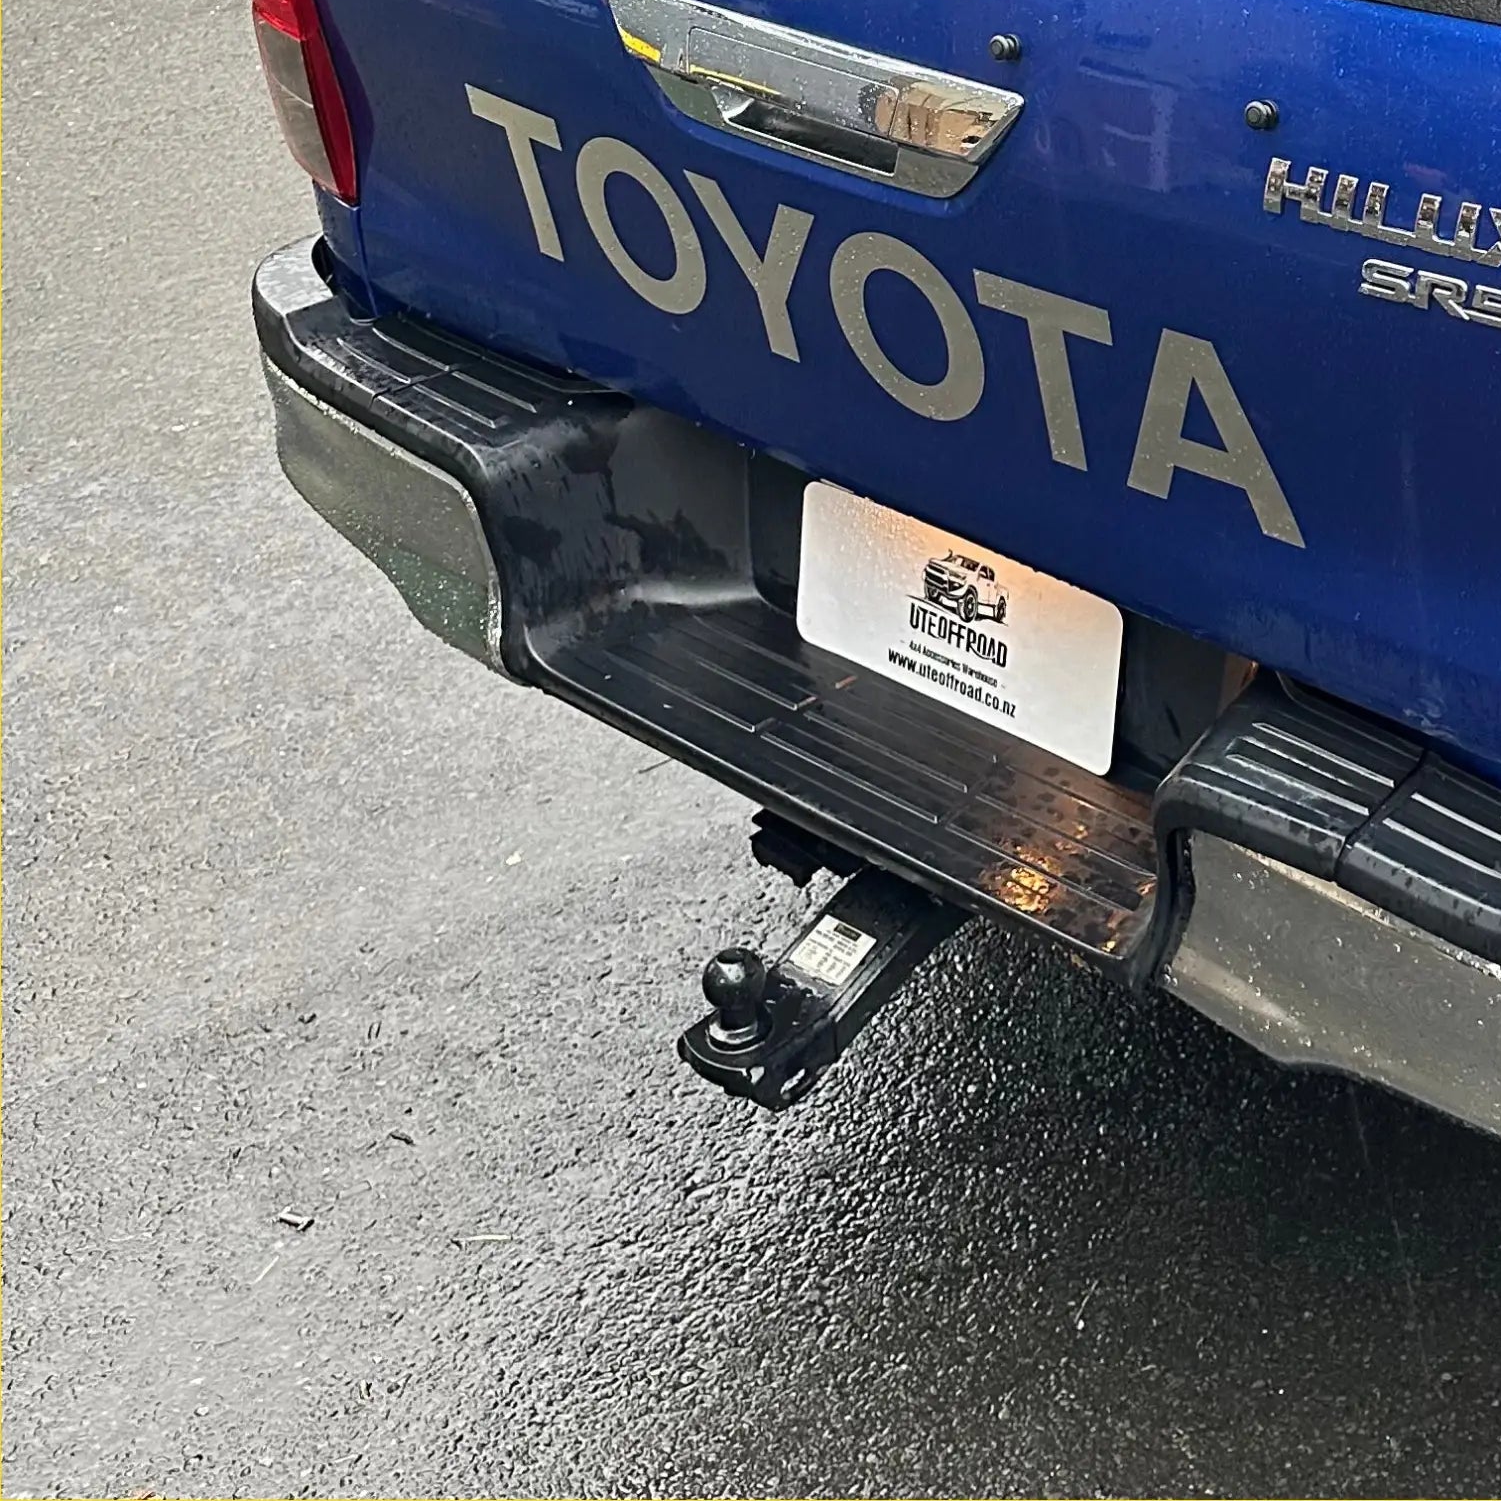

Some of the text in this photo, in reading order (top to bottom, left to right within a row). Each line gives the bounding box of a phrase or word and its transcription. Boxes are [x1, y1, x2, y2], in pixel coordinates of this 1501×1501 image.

[465, 83, 1305, 549] TOYOTA
[909, 602, 1008, 668] UTEOFFROAD
[888, 648, 1016, 718] www.uteoffroad.co.nz
